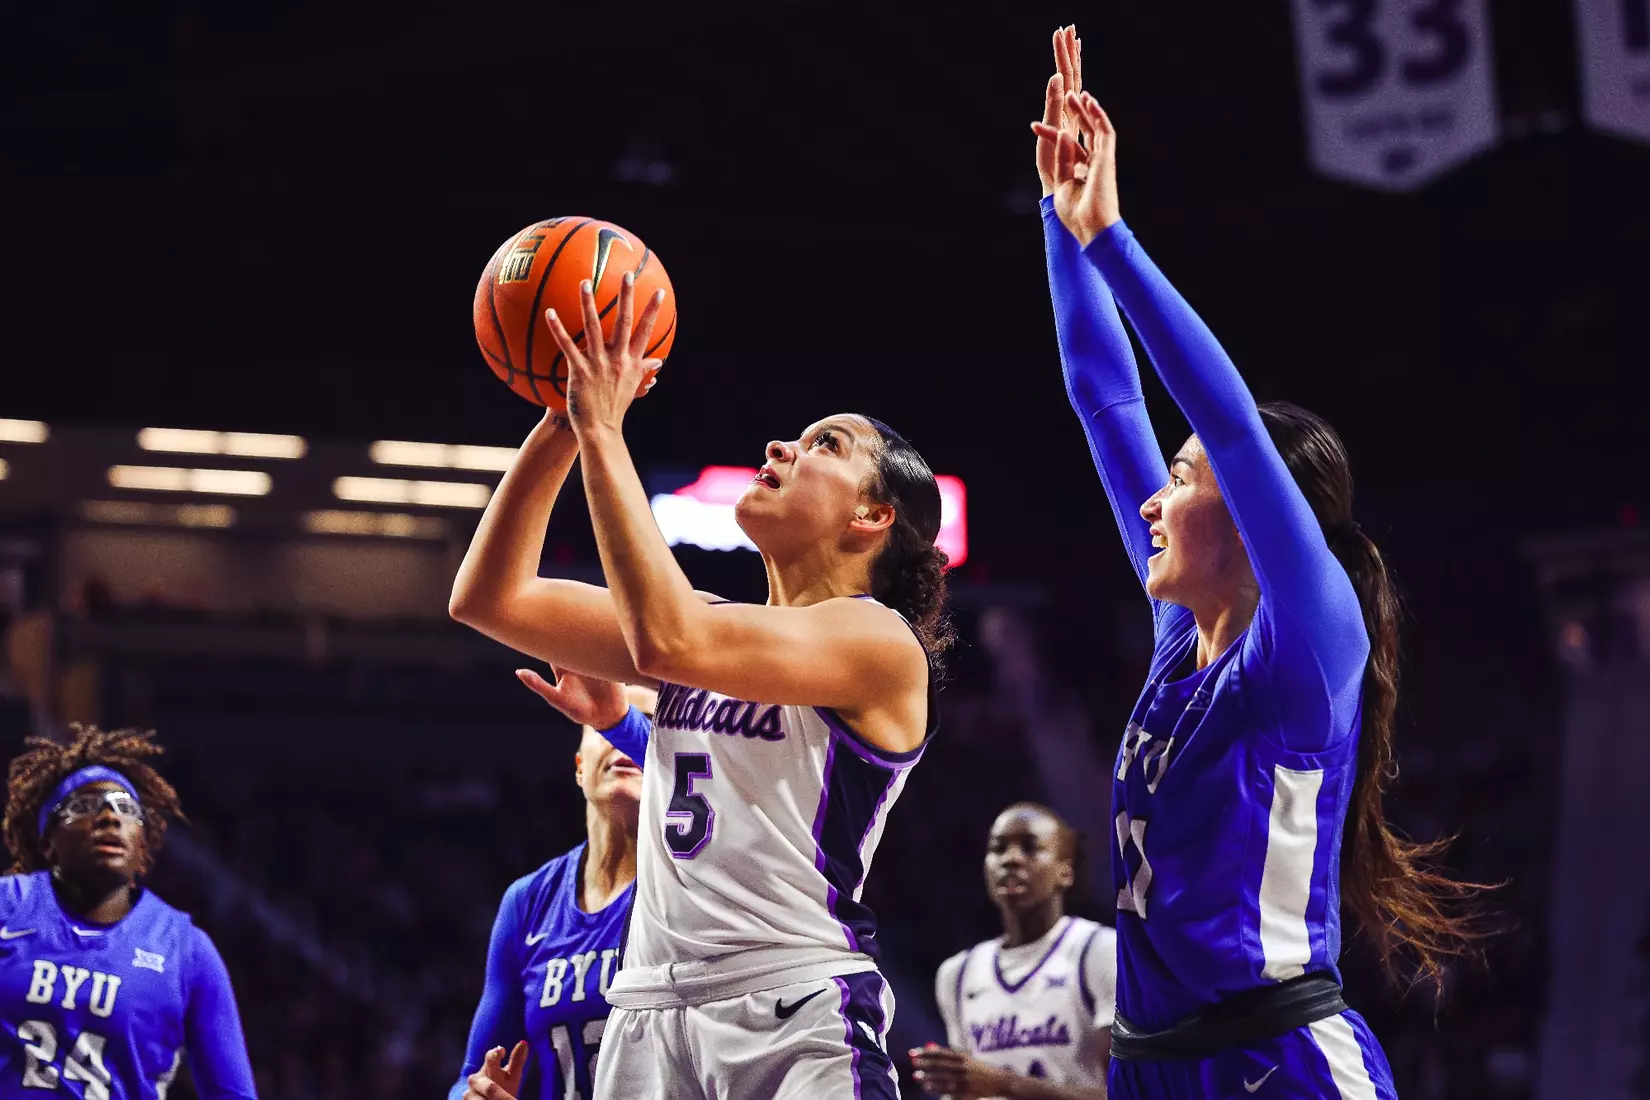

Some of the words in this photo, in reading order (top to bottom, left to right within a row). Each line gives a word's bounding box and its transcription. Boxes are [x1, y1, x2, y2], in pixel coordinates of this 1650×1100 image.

[1314, 0, 1472, 98] 33
[664, 752, 716, 860] 5
[26, 959, 121, 1018] BYU
[18, 1019, 111, 1100] 24
